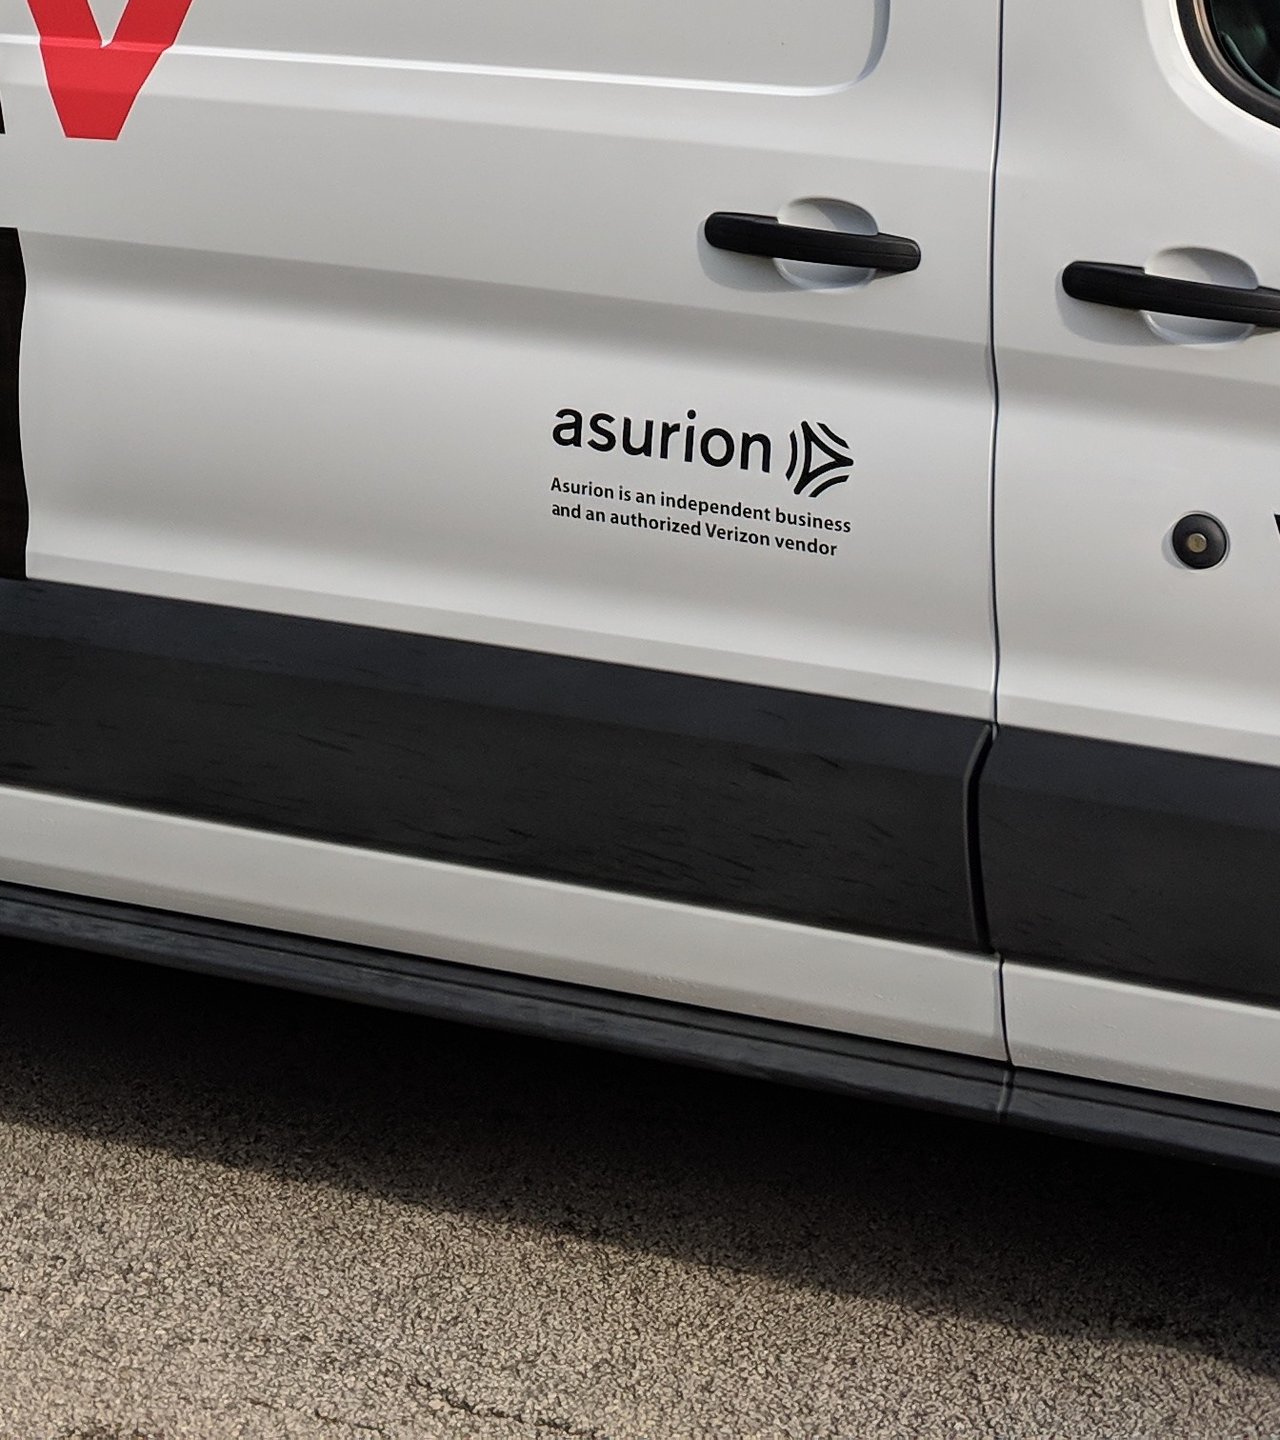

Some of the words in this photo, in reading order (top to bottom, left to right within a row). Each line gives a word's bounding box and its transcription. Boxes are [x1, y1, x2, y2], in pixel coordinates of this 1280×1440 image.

[551, 407, 772, 474] asurion
[550, 476, 614, 500] Asurion
[618, 485, 632, 502] is
[635, 491, 656, 506] an
[660, 491, 771, 522] independent
[775, 506, 852, 533] business
[551, 503, 582, 519] and
[585, 509, 606, 523] an
[609, 512, 702, 537] authorized
[704, 522, 771, 547] Verizon
[774, 536, 839, 557] vendor
